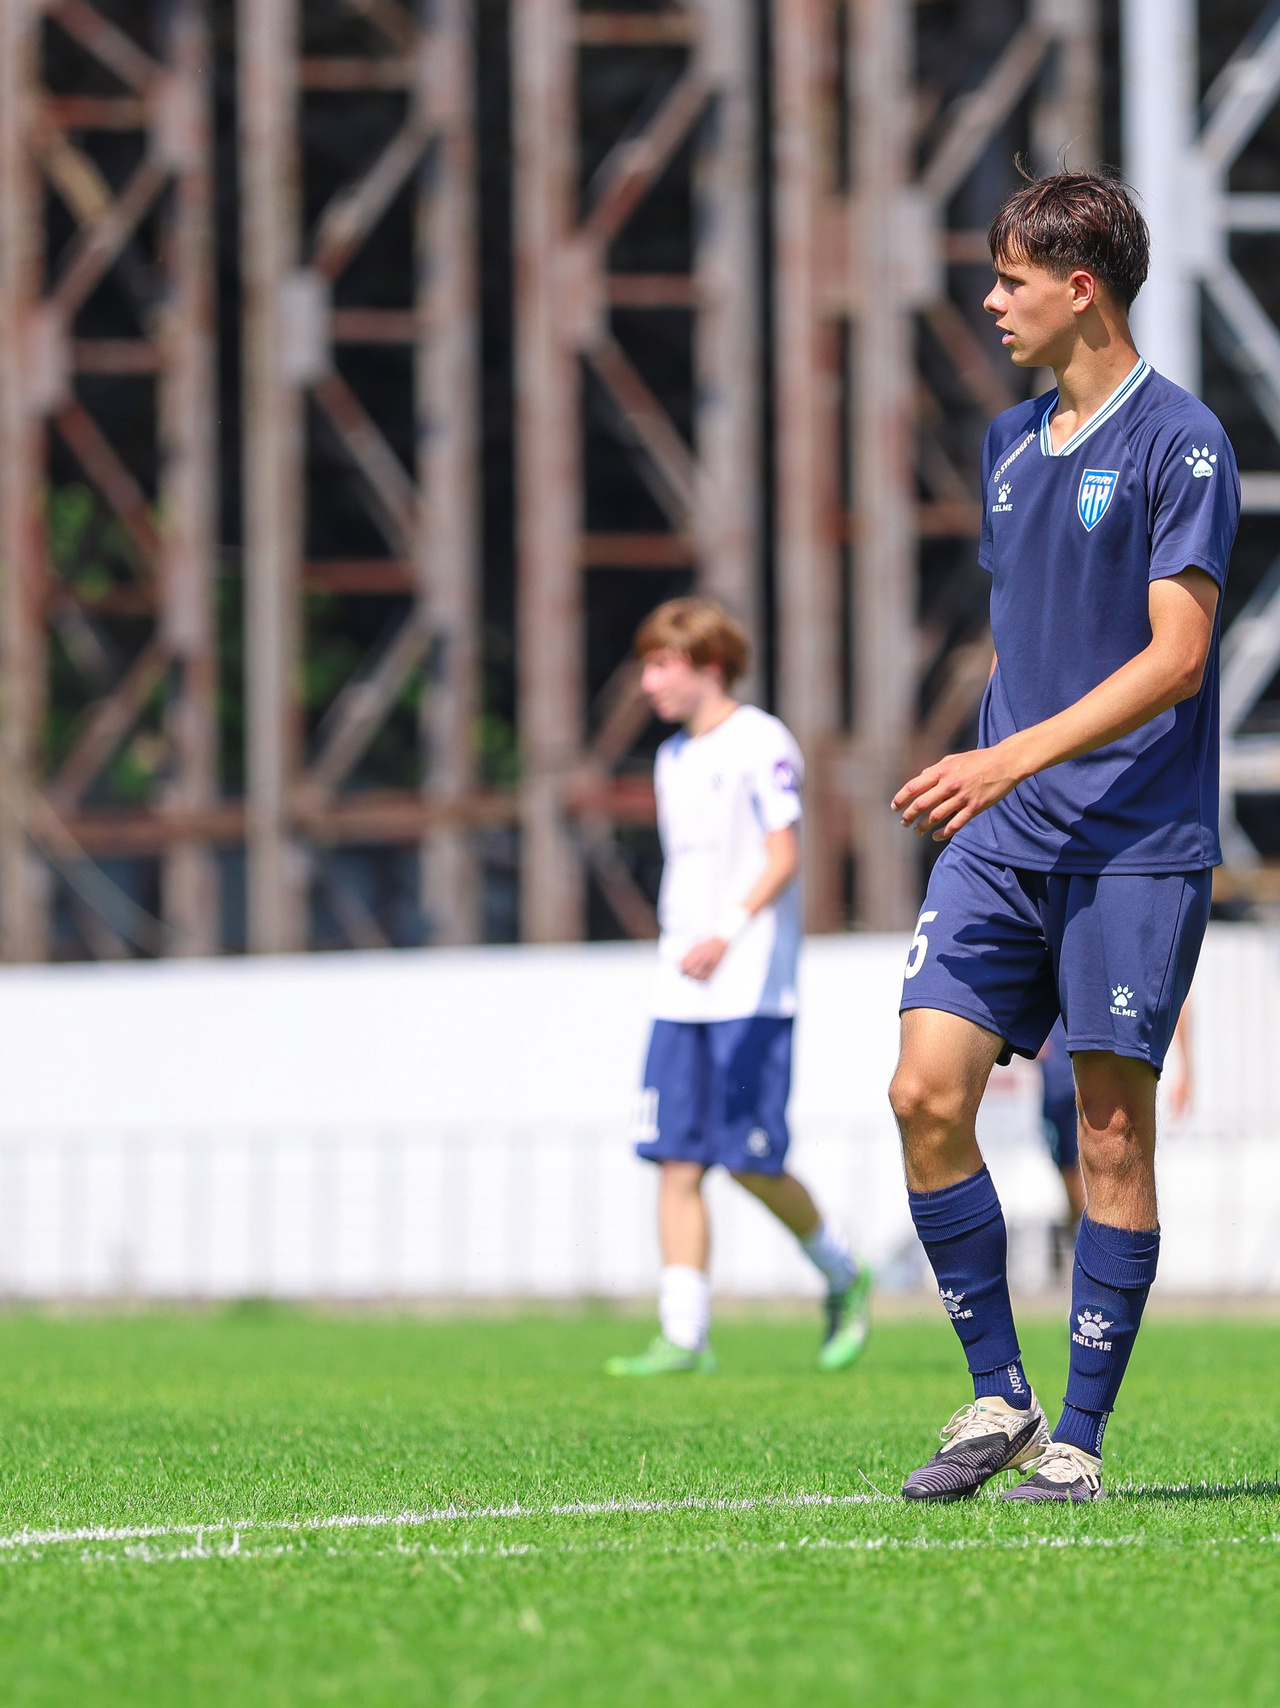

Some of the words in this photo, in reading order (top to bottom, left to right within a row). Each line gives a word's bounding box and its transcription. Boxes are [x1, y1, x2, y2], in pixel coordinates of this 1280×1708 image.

[1085, 474, 1113, 485] PARI
[992, 503, 1013, 513] KELME
[1072, 1332, 1112, 1351] KELME
